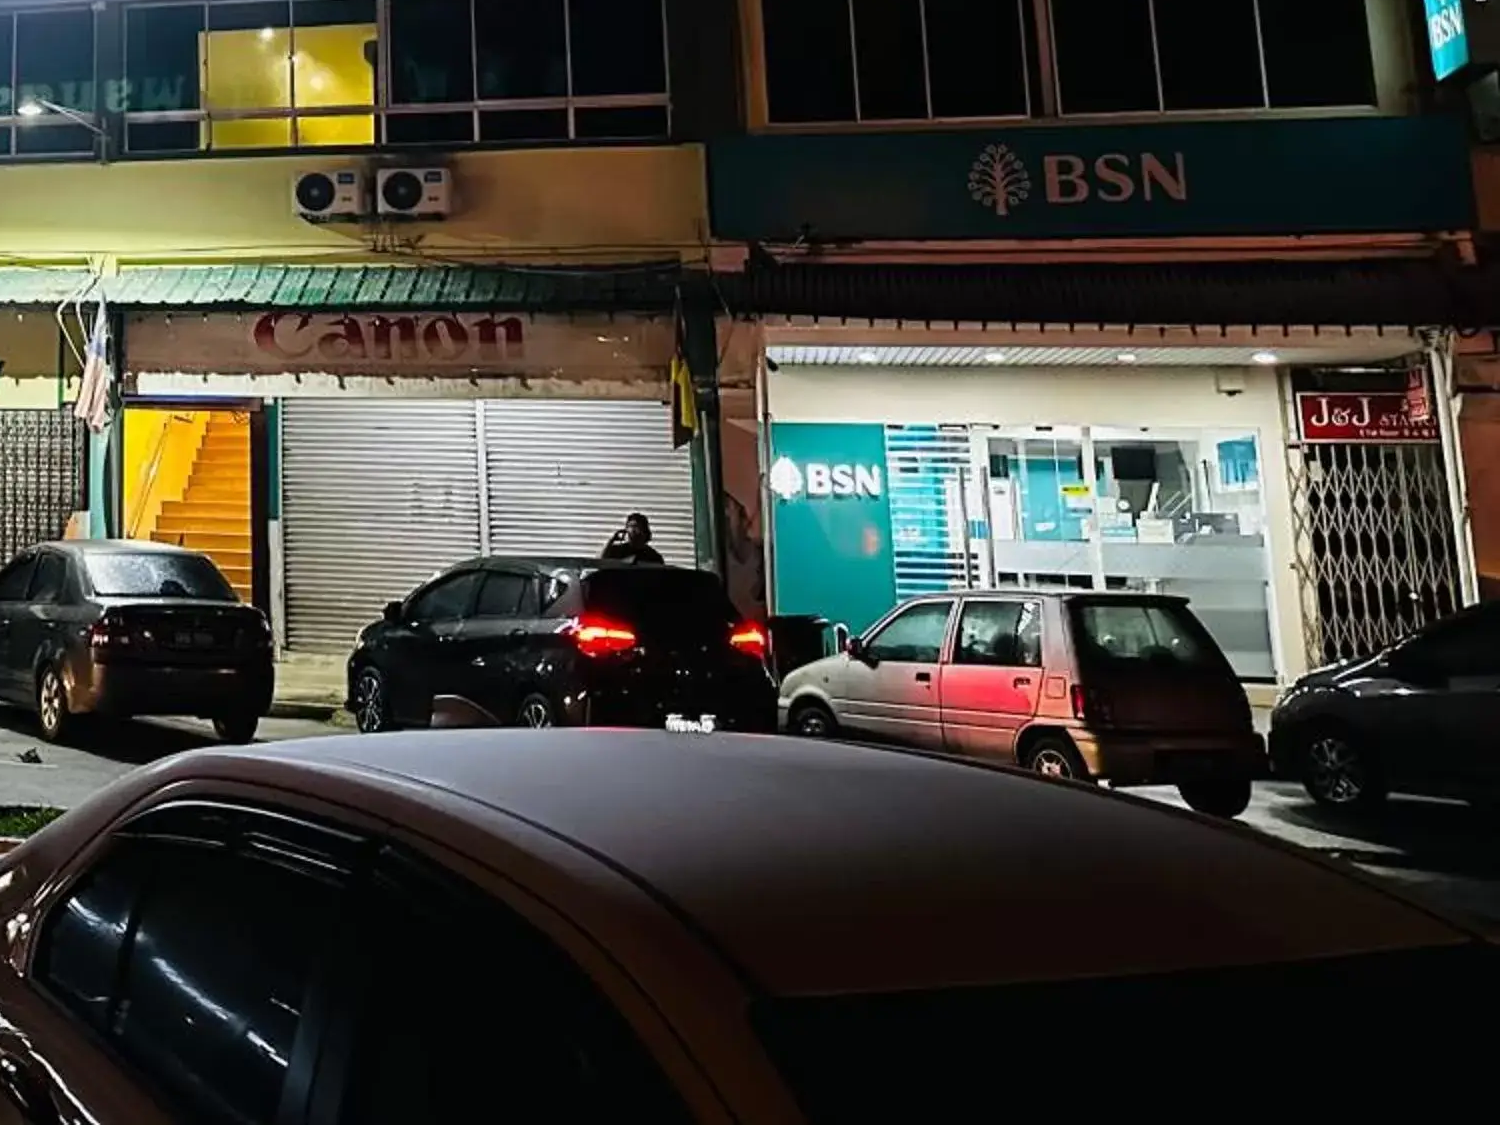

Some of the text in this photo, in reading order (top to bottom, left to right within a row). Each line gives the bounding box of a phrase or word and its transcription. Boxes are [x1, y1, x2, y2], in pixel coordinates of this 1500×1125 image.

[1043, 151, 1188, 206] BSN
[253, 311, 524, 361] Canon
[1310, 396, 1372, 427] J&J
[805, 462, 883, 497] BSN
